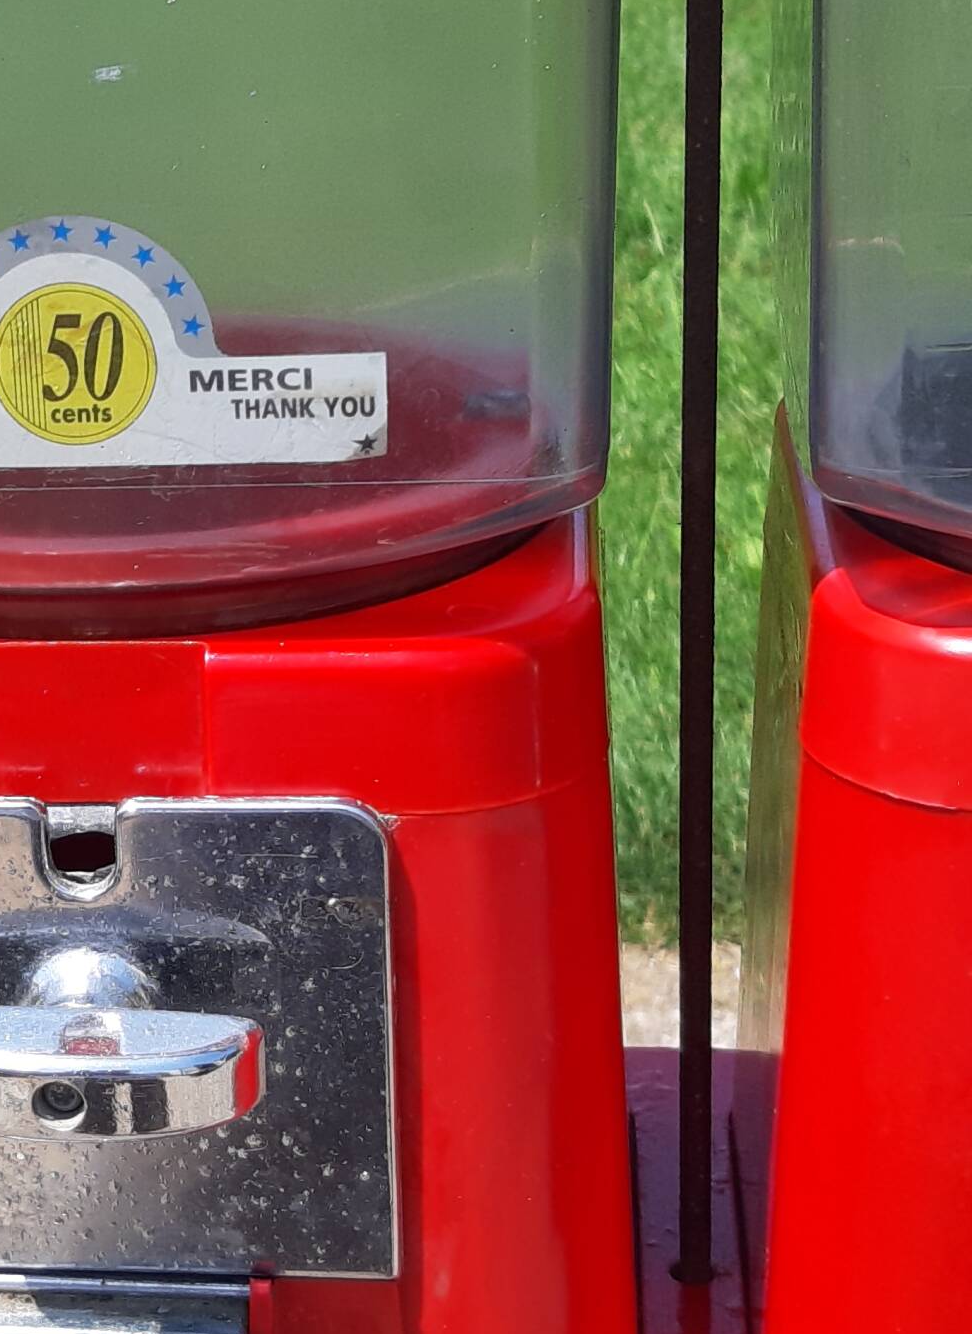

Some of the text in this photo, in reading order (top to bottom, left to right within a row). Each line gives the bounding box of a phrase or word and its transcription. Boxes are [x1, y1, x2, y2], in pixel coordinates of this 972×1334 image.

[43, 311, 124, 402] 50
[189, 368, 312, 393] MERCI
[51, 404, 113, 424] cents
[231, 396, 376, 420] THANK YOU
